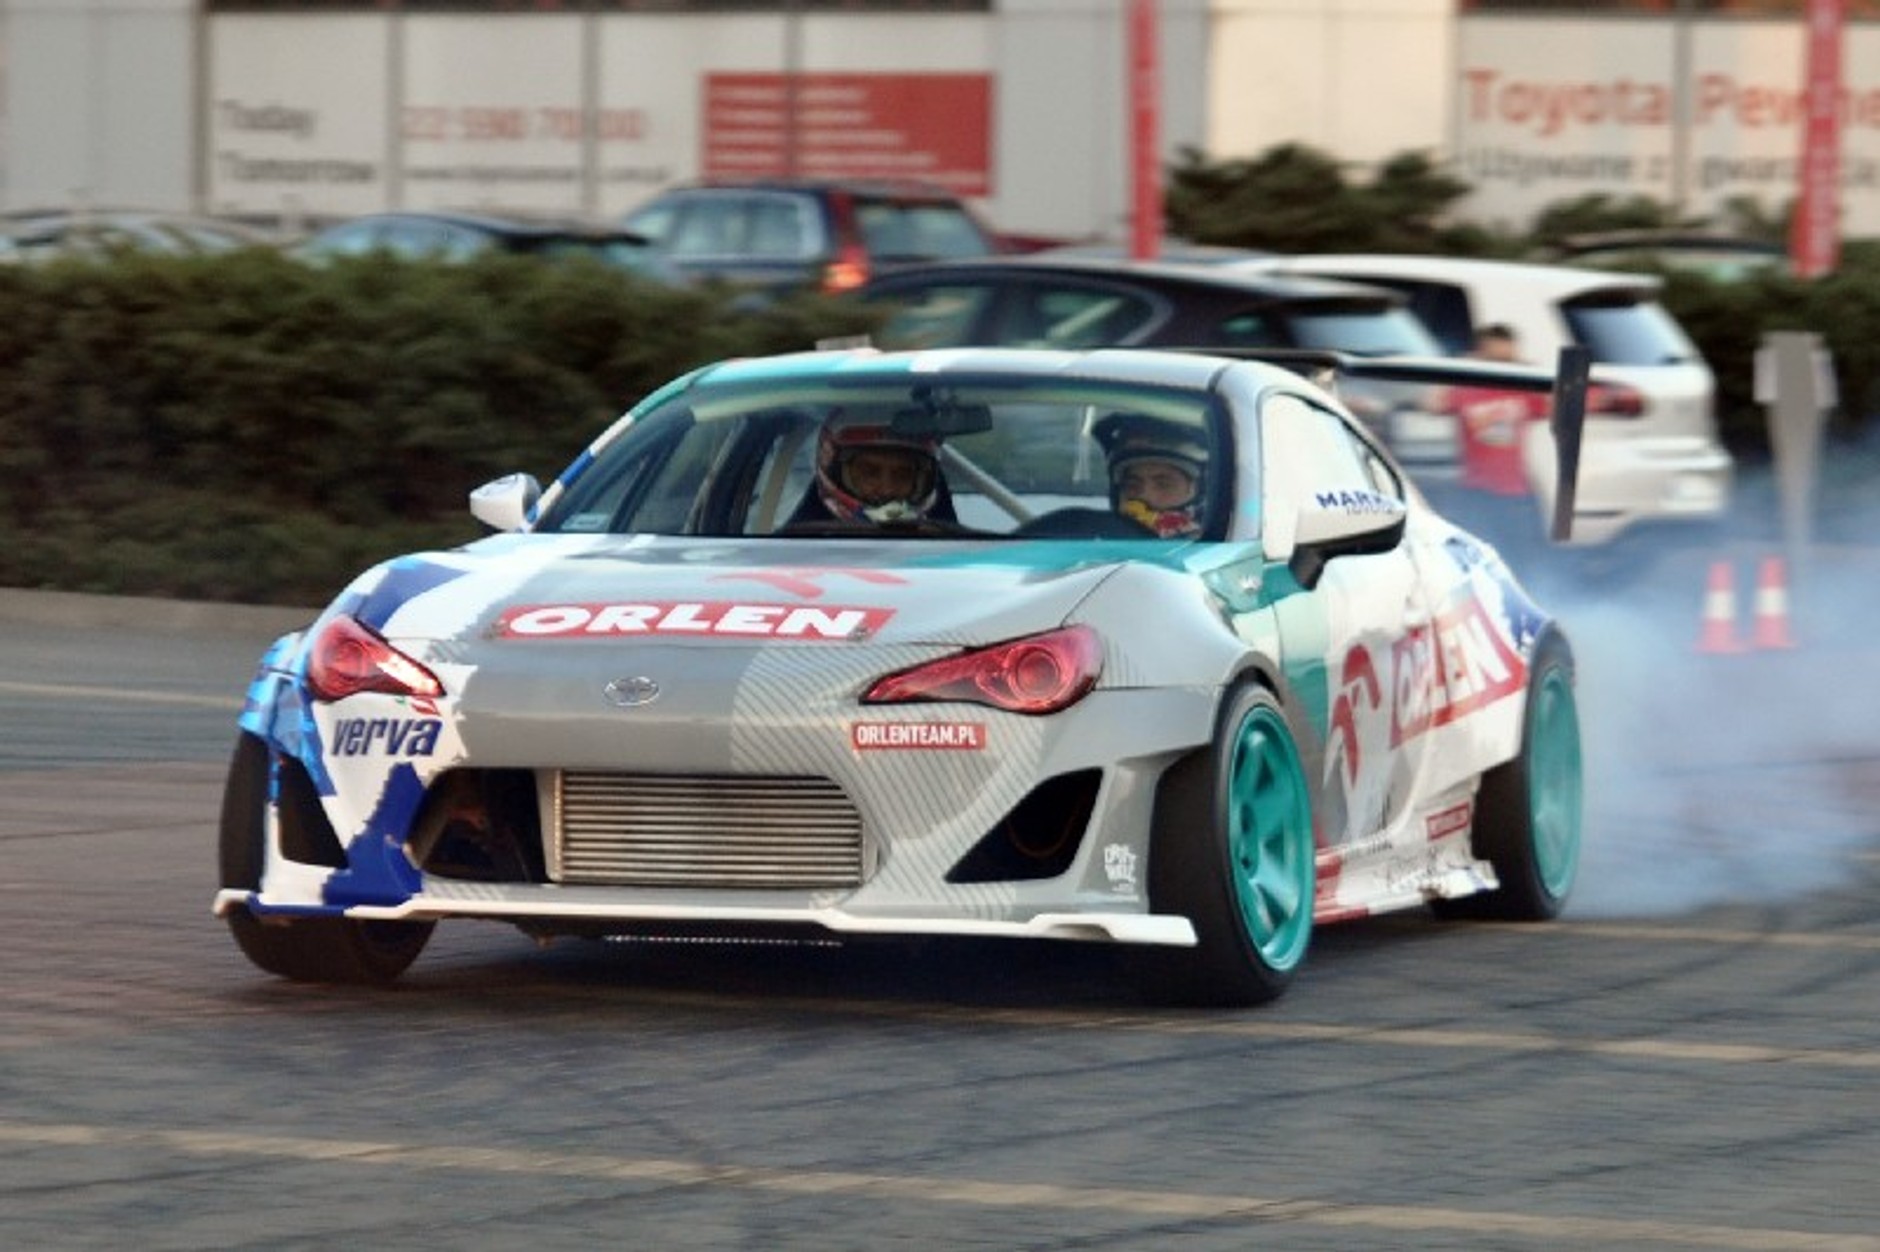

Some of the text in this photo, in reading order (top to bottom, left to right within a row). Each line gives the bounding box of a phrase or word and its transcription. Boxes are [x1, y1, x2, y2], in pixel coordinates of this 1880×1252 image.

[1466, 69, 1671, 137] Toyota
[509, 604, 866, 638] ORLEN
[331, 718, 443, 756] verva
[857, 724, 977, 746] ORLENTEAM.PL
